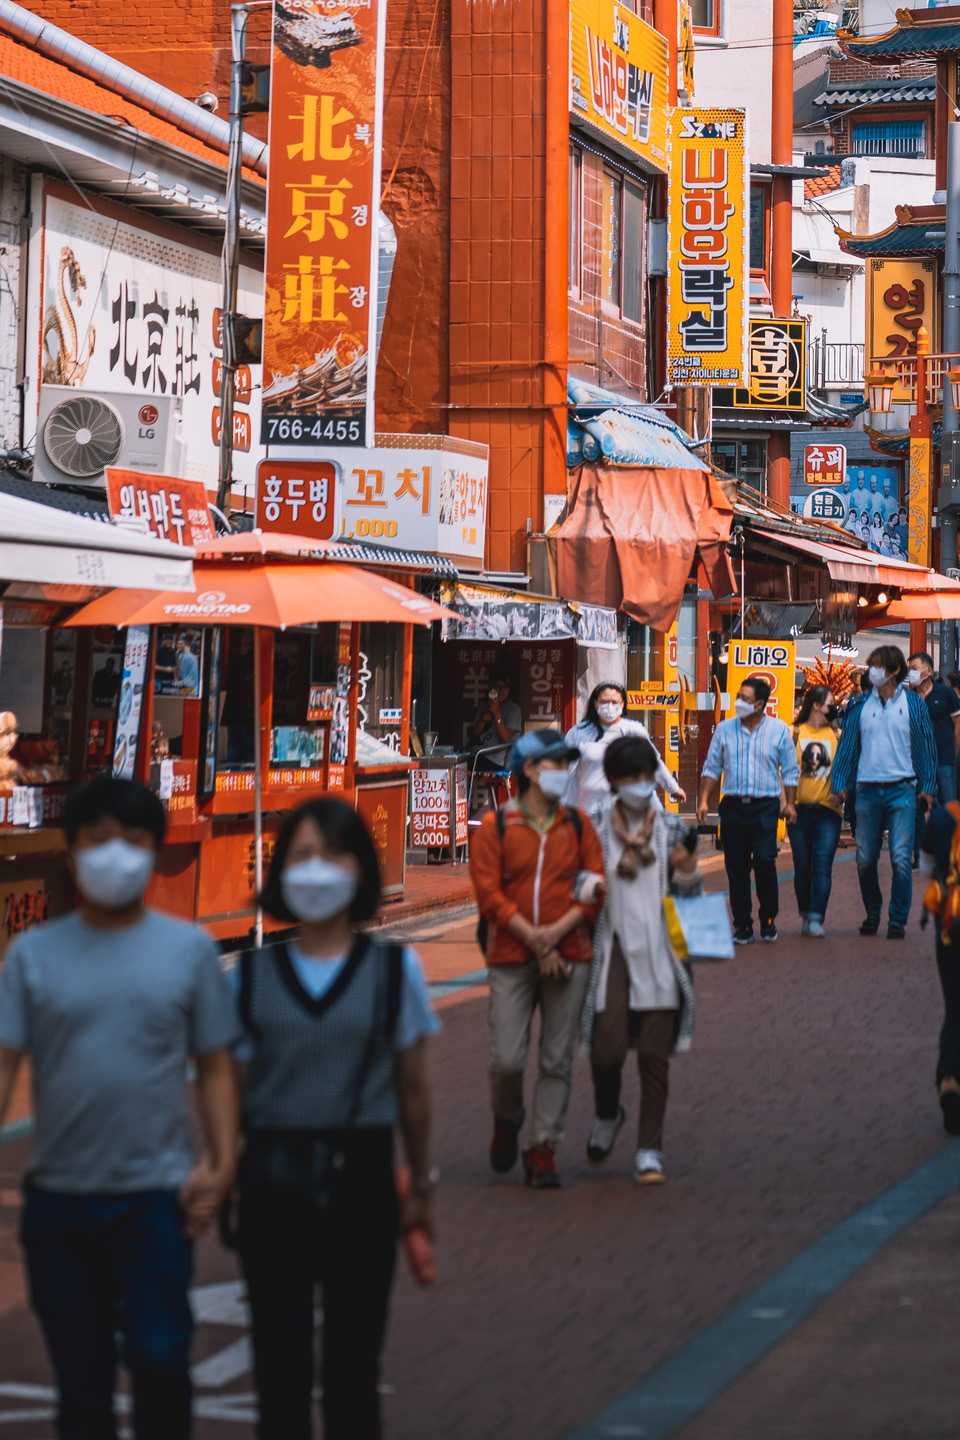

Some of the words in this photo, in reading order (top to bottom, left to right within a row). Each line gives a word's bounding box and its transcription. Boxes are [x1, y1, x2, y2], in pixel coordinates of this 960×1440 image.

[282, 94, 353, 323] 北京莊
[672, 369, 690, 379] 인천
[138, 428, 155, 440] LG
[267, 418, 360, 442] 766-4455
[807, 447, 843, 471] 슈퍼
[263, 475, 329, 522] 홍두병
[346, 466, 432, 515] 꼬치
[459, 471, 487, 525] 양꼬치
[814, 494, 834, 505] 현금
[813, 506, 843, 516] 지급기
[163, 603, 251, 615] TSINGTAO
[734, 645, 789, 667] 니하오
[413, 779, 449, 795] 양꼬치
[413, 814, 450, 831] 칭따오
